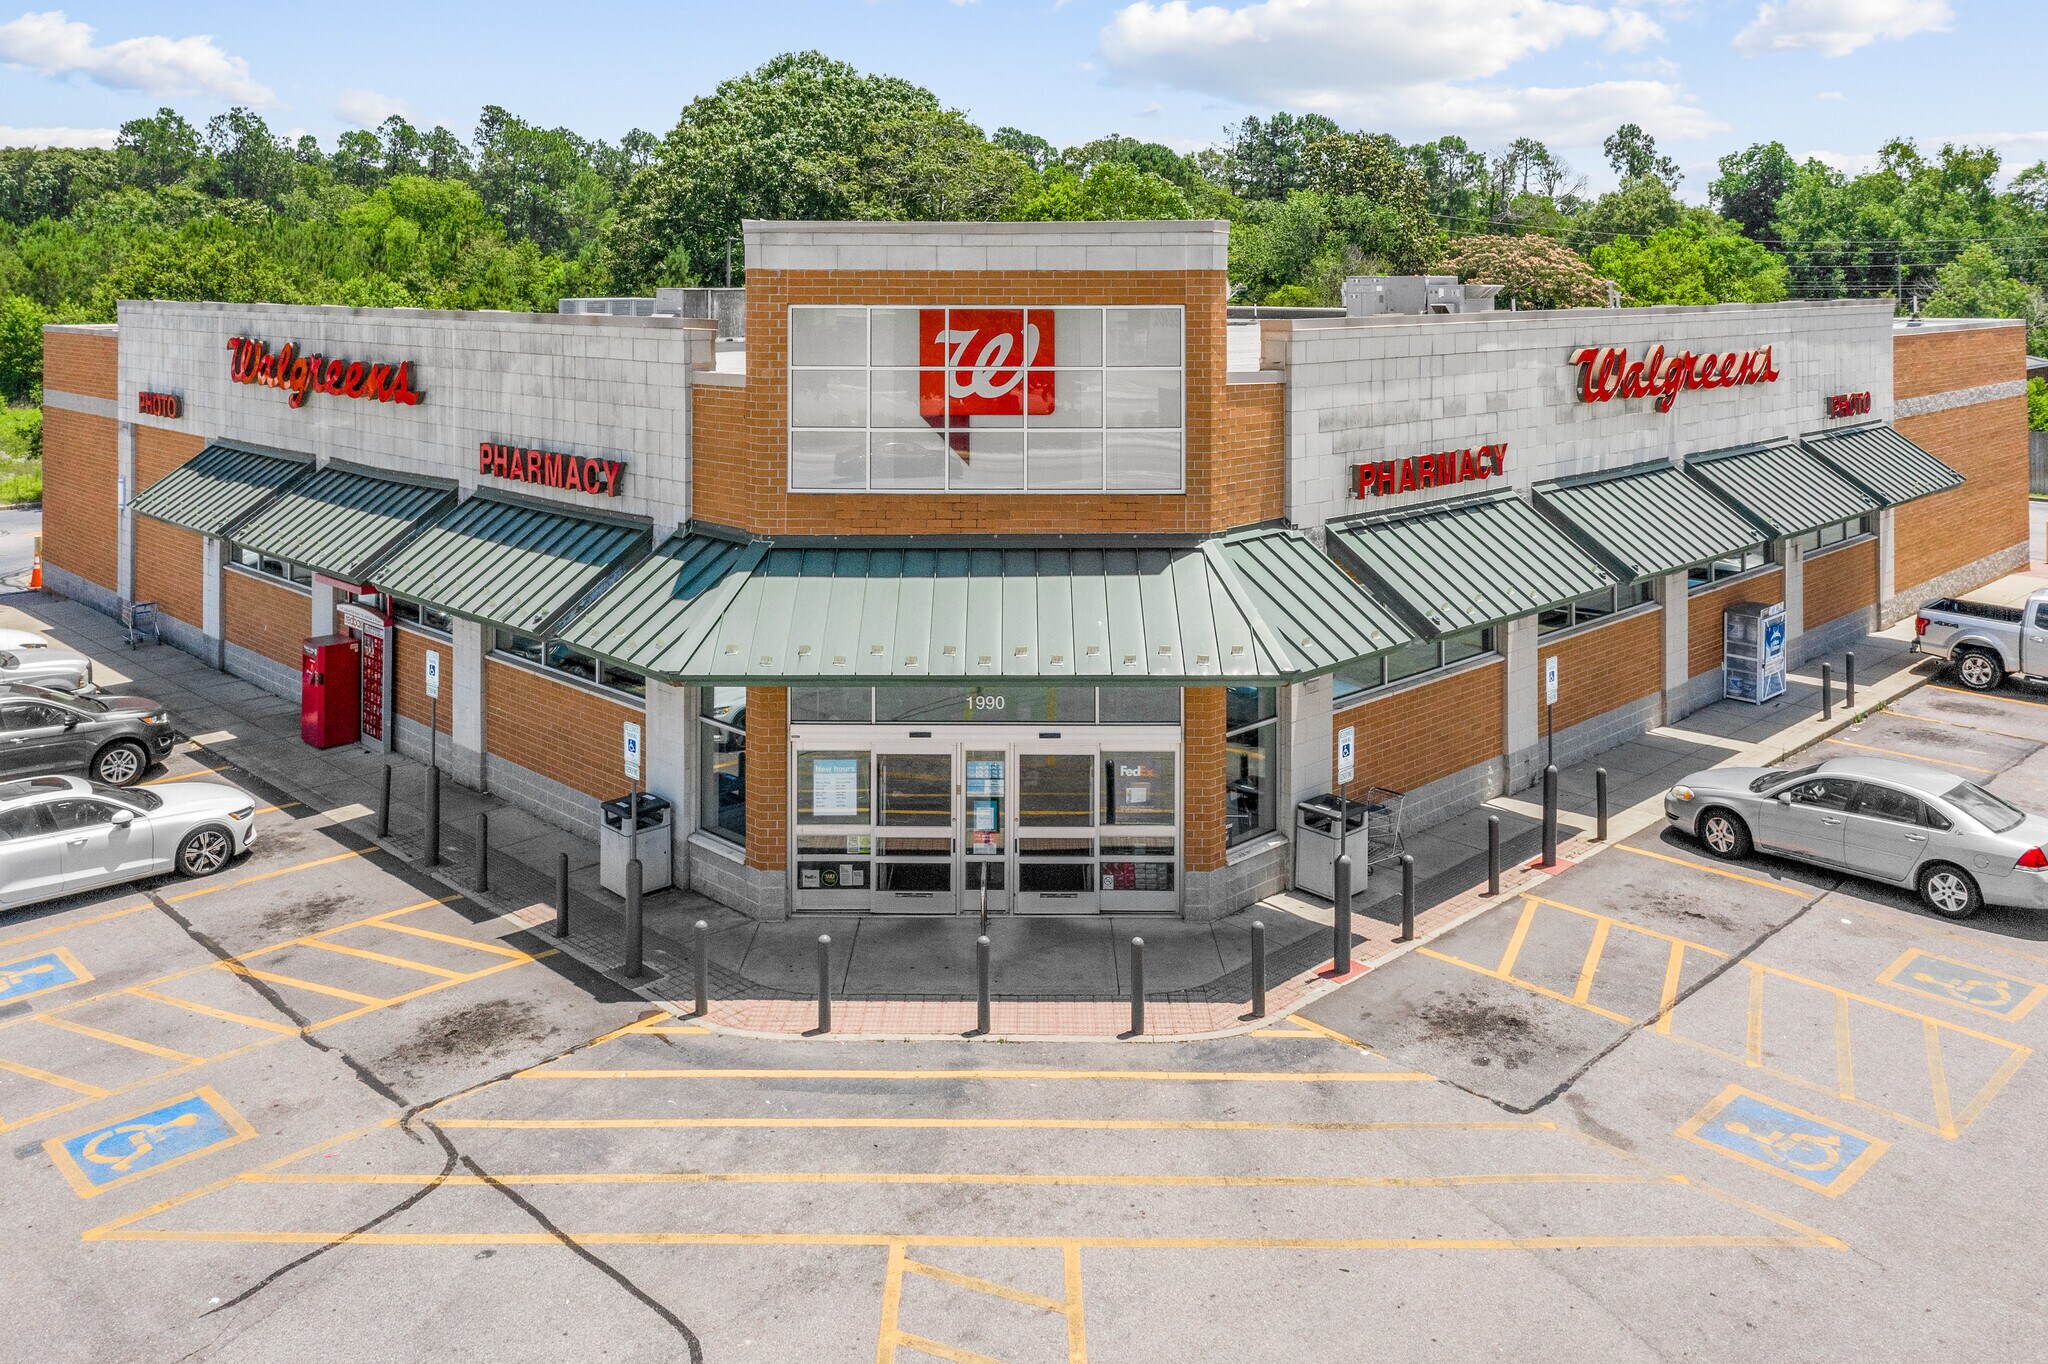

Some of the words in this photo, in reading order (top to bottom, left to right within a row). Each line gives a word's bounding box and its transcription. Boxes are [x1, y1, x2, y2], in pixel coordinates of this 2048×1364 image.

[227, 337, 424, 409] Walgreens
[1570, 344, 1780, 413] Walgreens
[139, 391, 179, 419] PHOTO
[1830, 391, 1872, 419] PHOTO
[480, 442, 622, 497] PHARMACY
[1356, 443, 1508, 500] PHARMACY
[966, 695, 1005, 710] 1990
[815, 765, 832, 773] New
[834, 765, 855, 773] hours
[1120, 765, 1153, 777] FedEx
